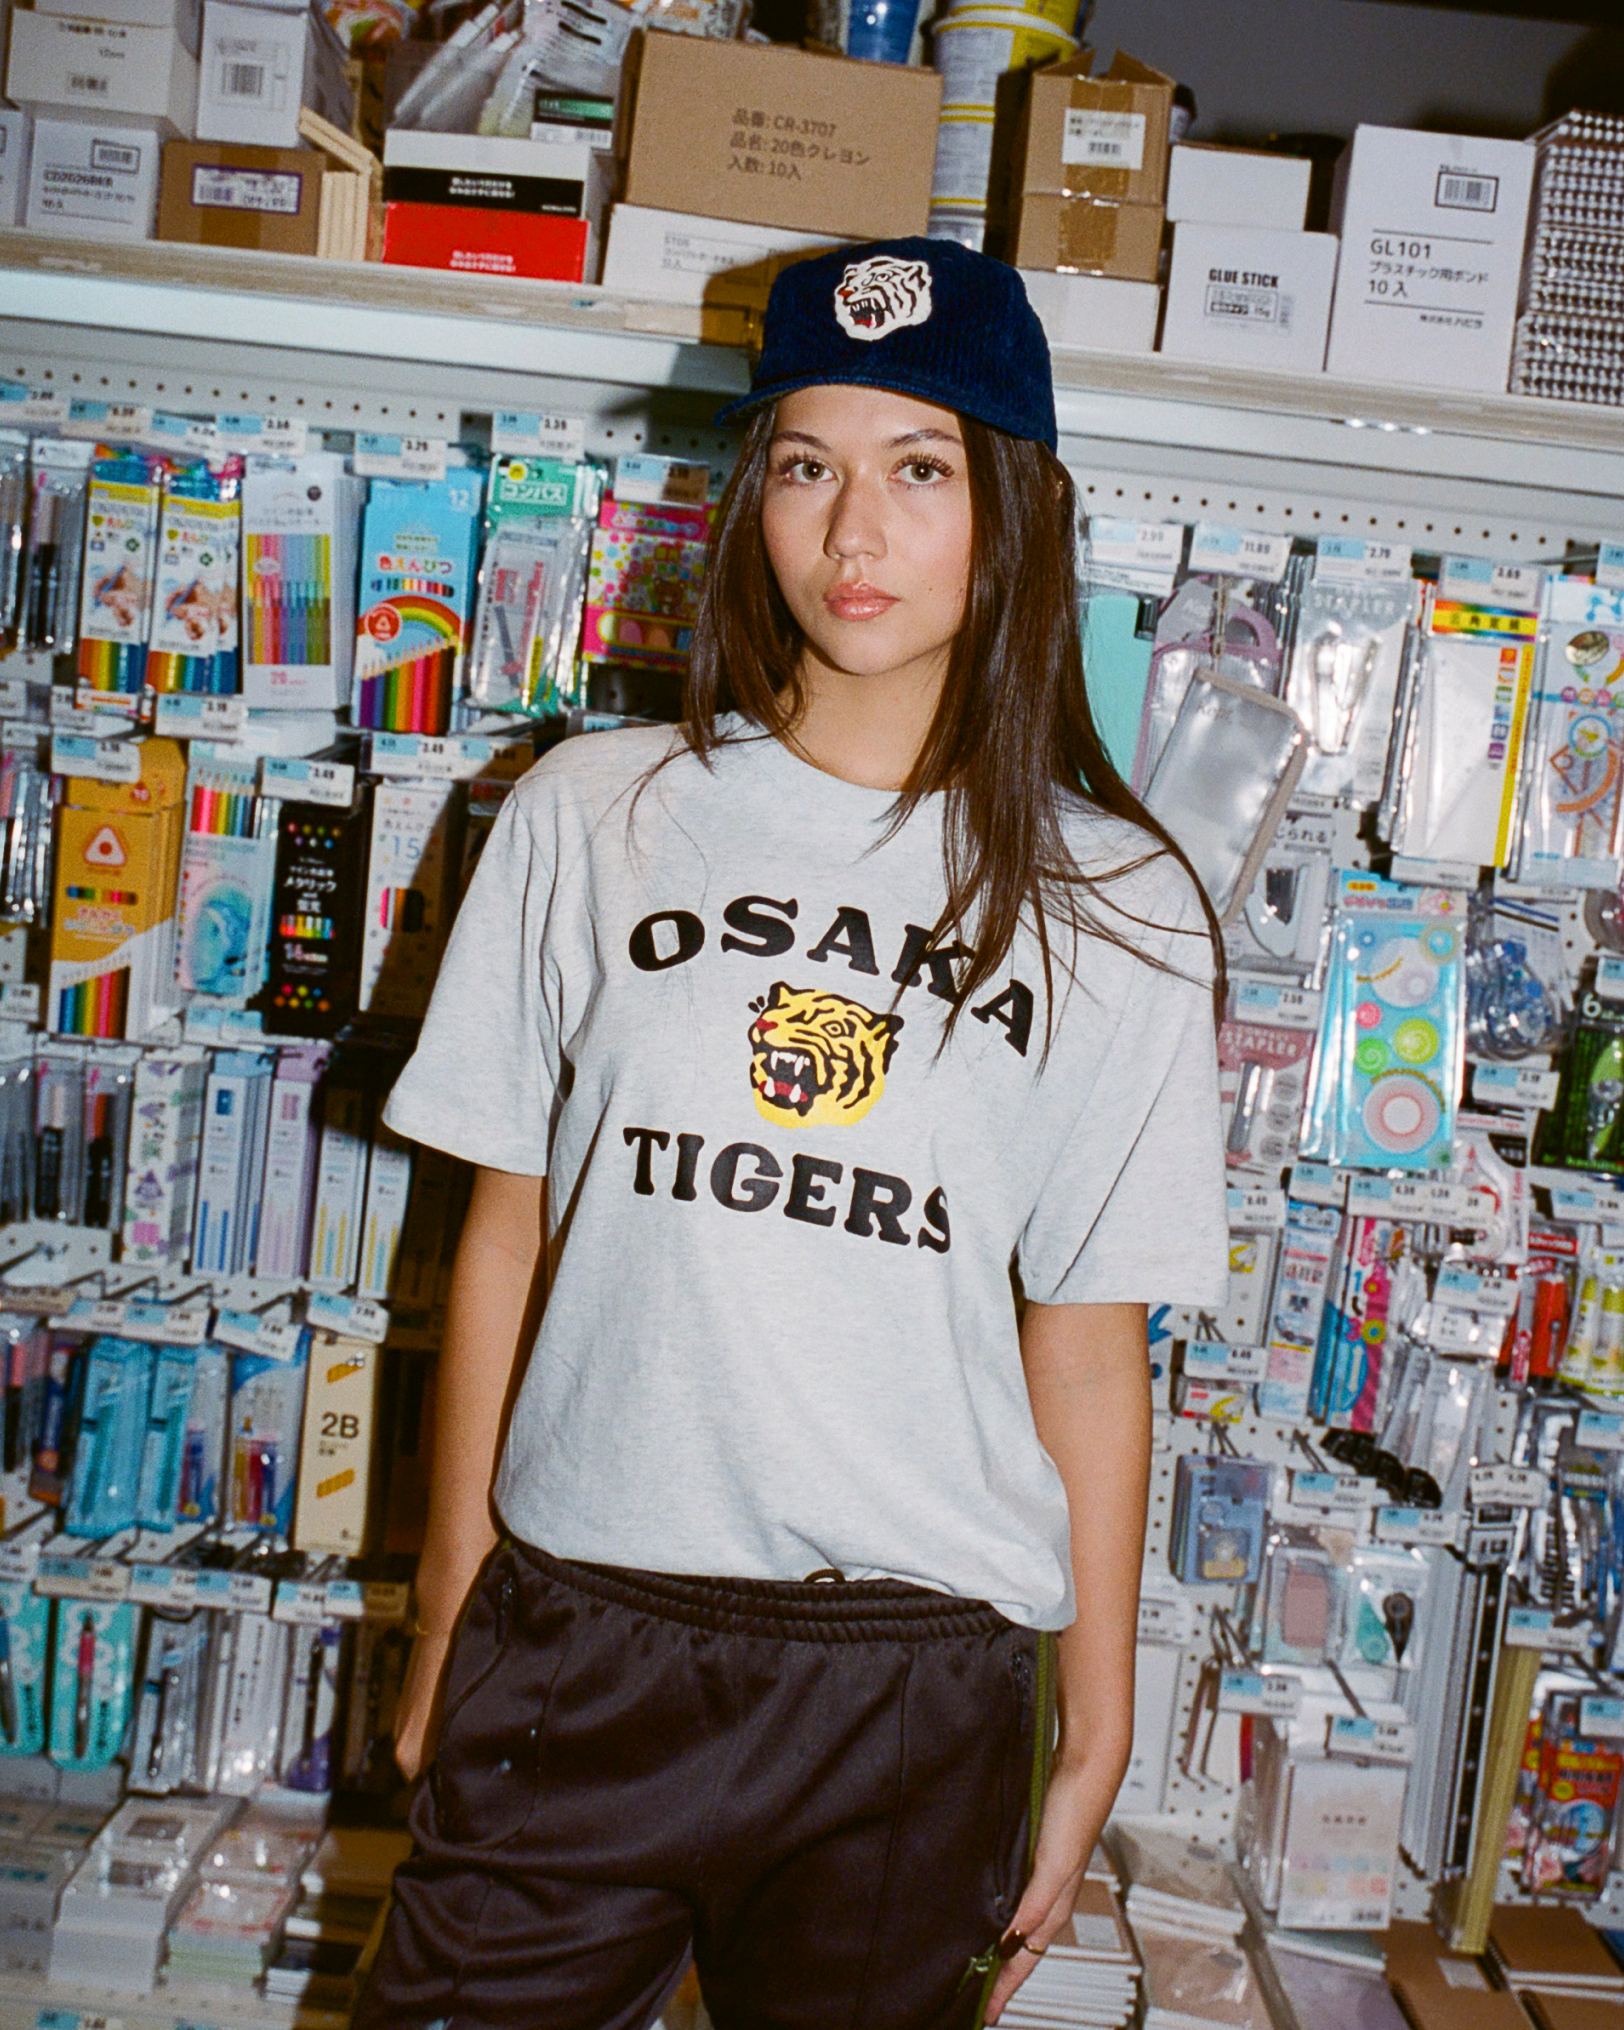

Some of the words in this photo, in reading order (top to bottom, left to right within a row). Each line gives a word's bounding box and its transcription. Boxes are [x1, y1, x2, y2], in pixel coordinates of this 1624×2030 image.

[1370, 239, 1432, 260] GL101
[1209, 268, 1238, 284] GLUE
[1242, 271, 1279, 288] STICK
[1369, 261, 1489, 285] プラスチック用ボンド
[449, 490, 469, 507] 12
[503, 483, 565, 501] コンパス
[378, 555, 453, 574] 色えんぴつ
[393, 834, 422, 860] 15
[284, 876, 337, 893] メタリック
[628, 894, 1034, 1057] OSAKA
[1583, 993, 1602, 1018] 6
[1224, 1031, 1297, 1056] STAPLER
[622, 1126, 952, 1254] TIGERS
[320, 1410, 360, 1440] 2B
